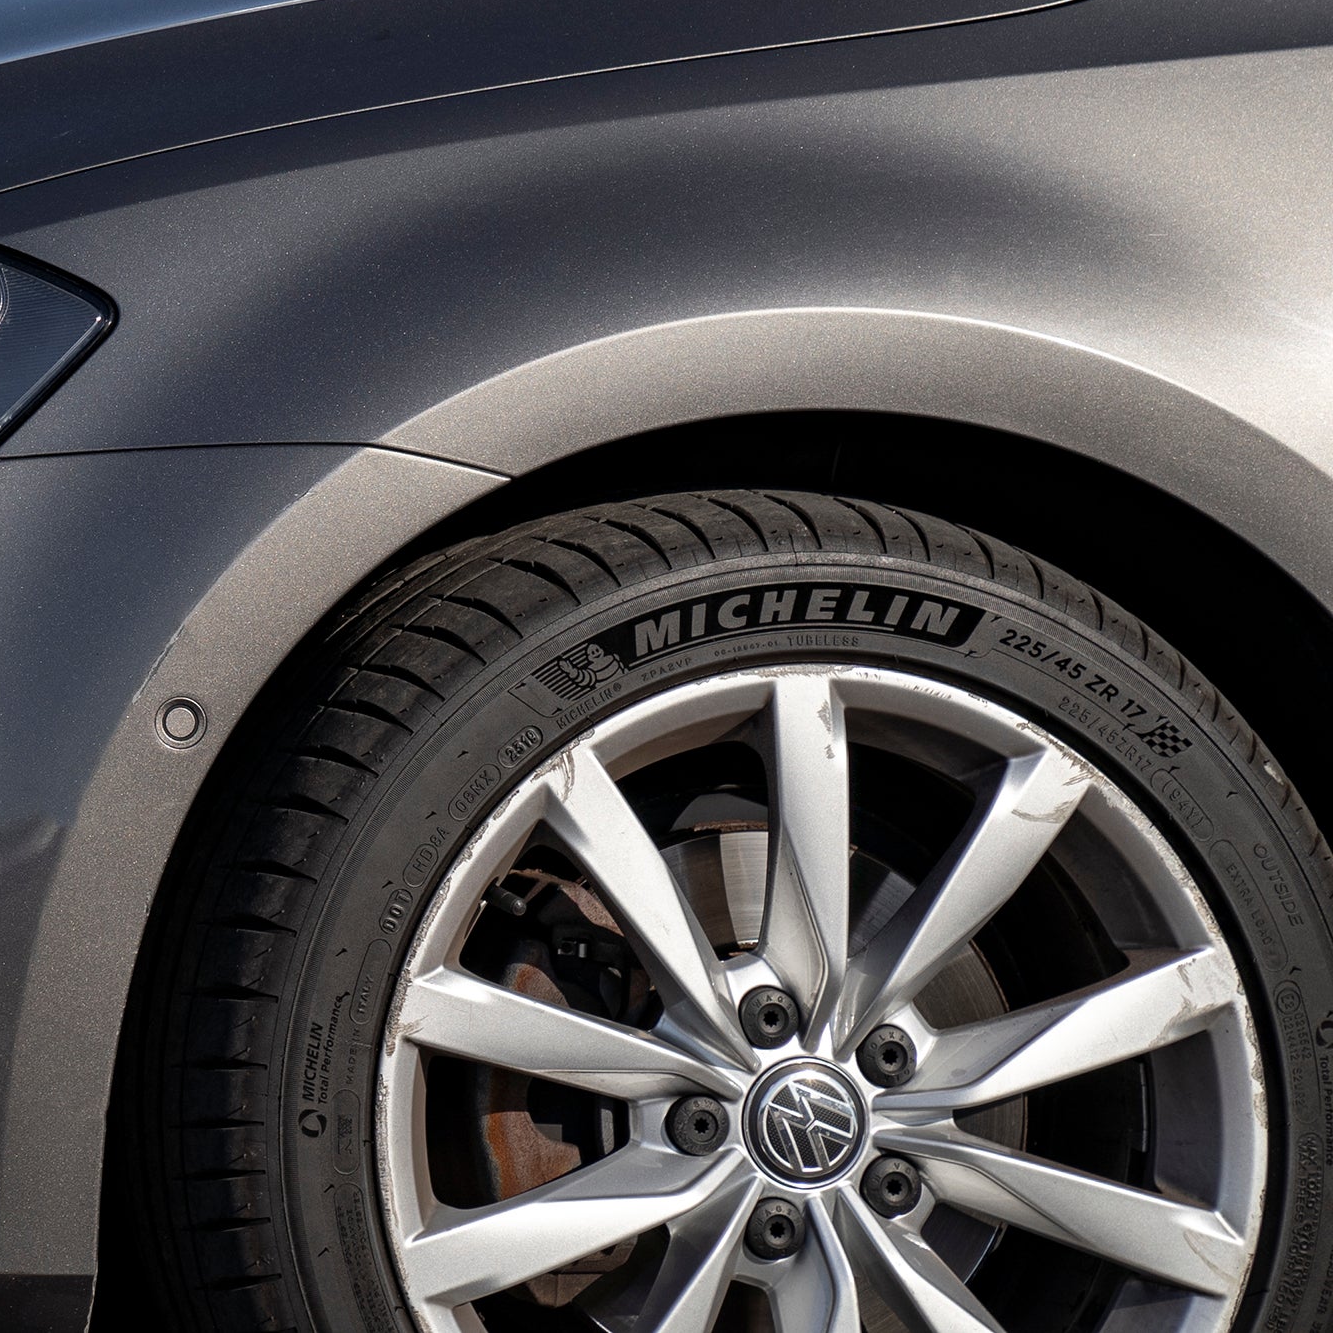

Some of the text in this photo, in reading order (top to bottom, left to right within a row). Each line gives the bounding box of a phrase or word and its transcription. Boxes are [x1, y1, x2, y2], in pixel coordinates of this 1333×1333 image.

[634, 588, 961, 657] MICHELIN
[786, 632, 860, 649] TUBELESS
[998, 628, 1148, 720] 225/45 ZR 17
[1224, 865, 1255, 905] EXTRA
[1252, 842, 1305, 928] OUTSIDE
[301, 1021, 324, 1101] MICHELIN
[317, 994, 344, 1104] Total Performance
[1319, 1056, 1333, 1085] Total
